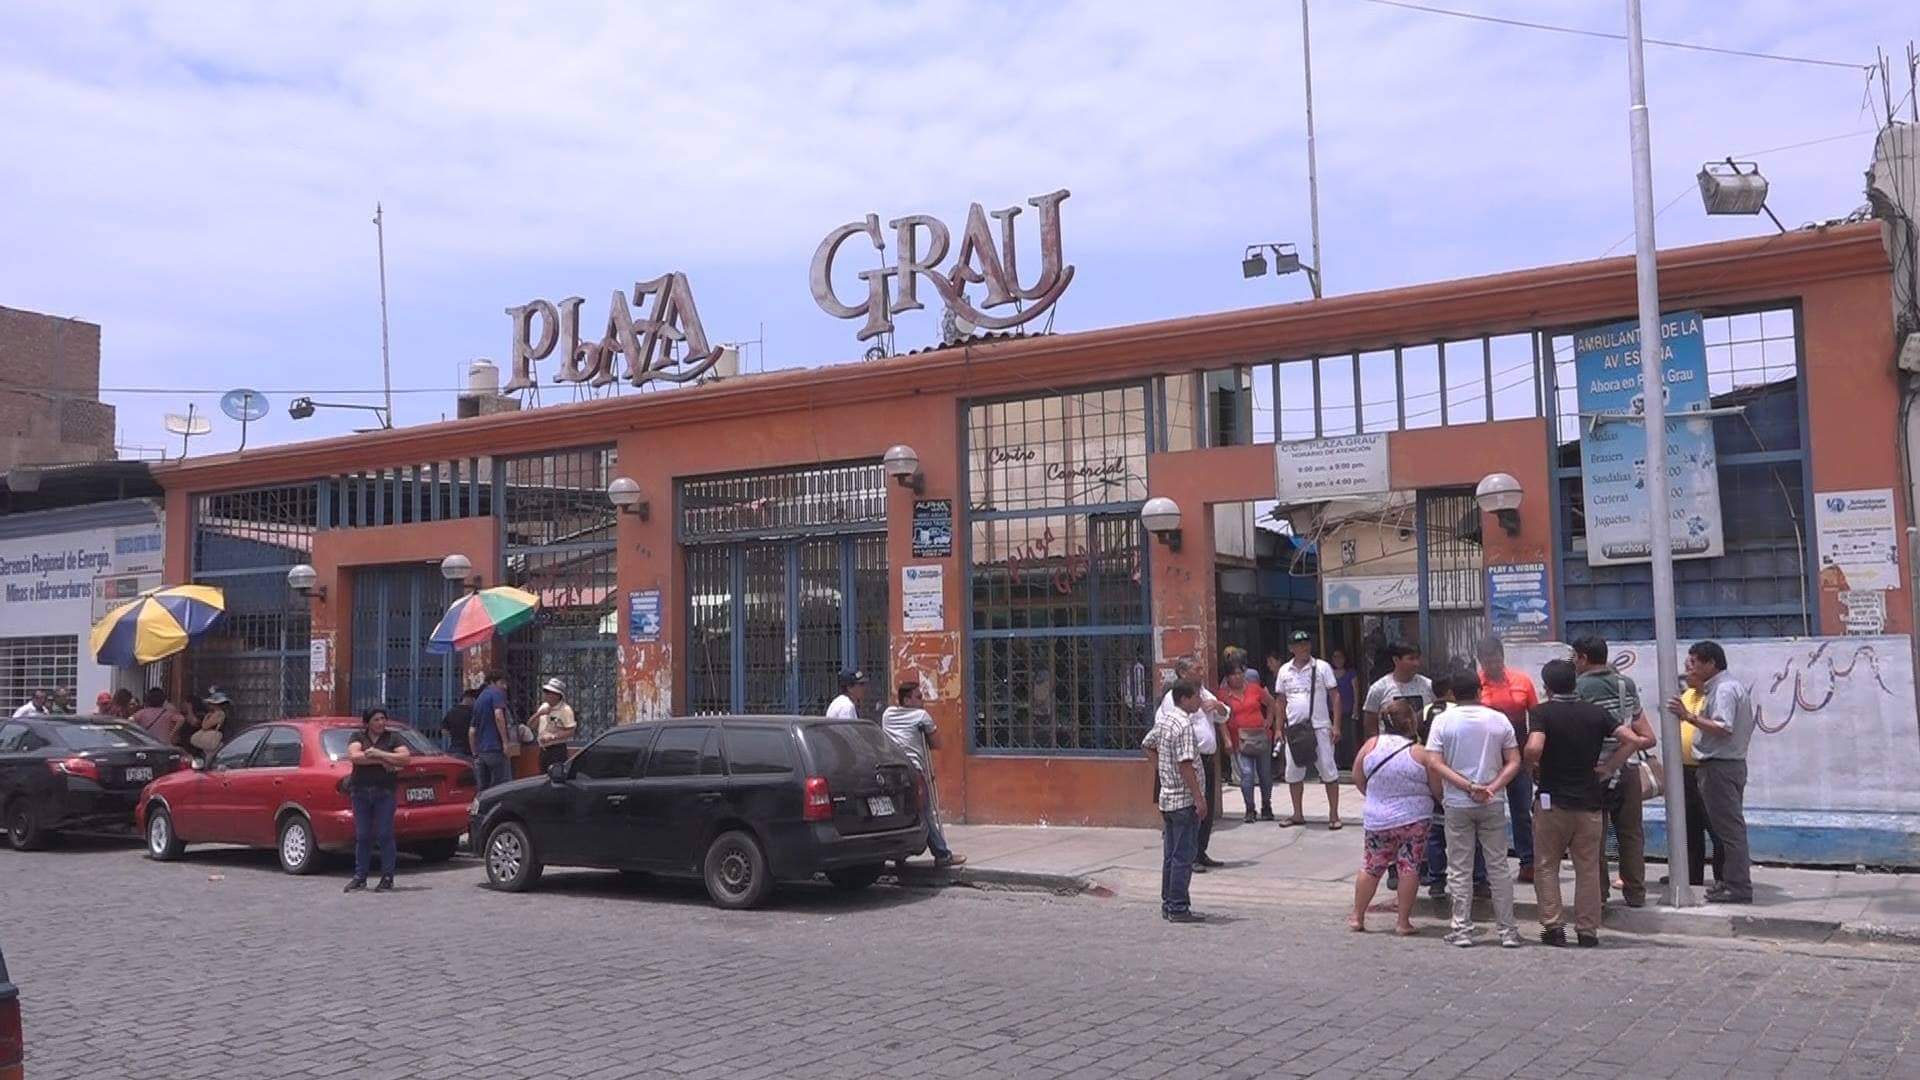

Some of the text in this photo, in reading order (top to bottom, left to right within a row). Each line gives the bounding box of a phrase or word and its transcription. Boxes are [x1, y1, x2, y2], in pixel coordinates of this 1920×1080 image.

[503, 188, 1075, 395] PLAZA GRAU
[1661, 322, 1678, 338] DE
[1681, 319, 1699, 336] LA
[1604, 354, 1621, 369] AV.
[1590, 379, 1620, 394] Ahora
[1622, 376, 1635, 388] en
[1667, 368, 1694, 383] Grau
[988, 447, 1036, 465] Centro
[1292, 451, 1323, 459] HORARIO
[1047, 456, 1125, 481] Comercial
[1592, 472, 1632, 485] Sandalias
[1593, 493, 1629, 505] Carteras
[1594, 514, 1632, 529] Juguetes
[1613, 542, 1644, 554] muchos
[32, 551, 66, 577] Regional
[66, 551, 77, 570] de
[1515, 563, 1545, 573] WORLD
[6, 579, 91, 602] Minas e Hidrocarburos
